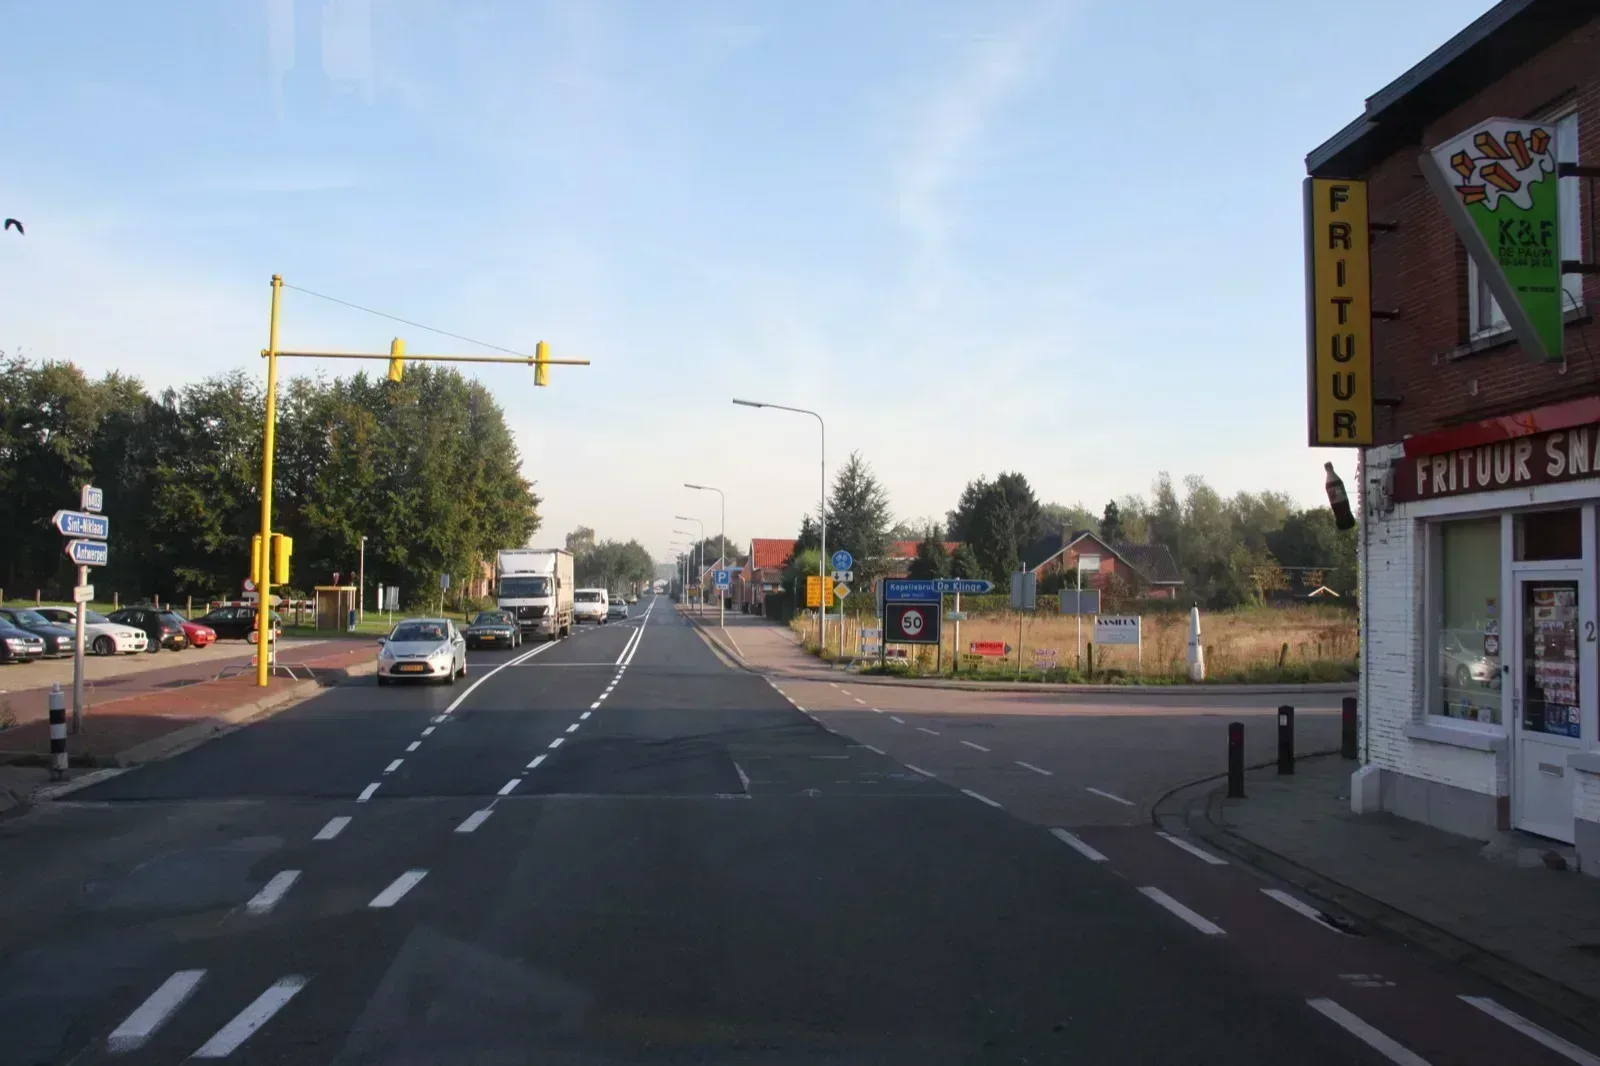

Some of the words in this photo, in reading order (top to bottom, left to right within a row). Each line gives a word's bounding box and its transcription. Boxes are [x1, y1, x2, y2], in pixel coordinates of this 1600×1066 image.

[1499, 218, 1553, 247] K&F
[1499, 247, 1514, 256] DE
[1328, 184, 1357, 439] FRITUUR
[1416, 440, 1532, 495] FRITUUR
[67, 516, 103, 535] Sint-Niklaas
[76, 545, 106, 562] Antwerpen
[718, 572, 727, 583] P
[937, 582, 949, 590] De
[953, 582, 981, 592] Klinge
[903, 616, 922, 629] 50
[1585, 620, 1596, 642] 2
